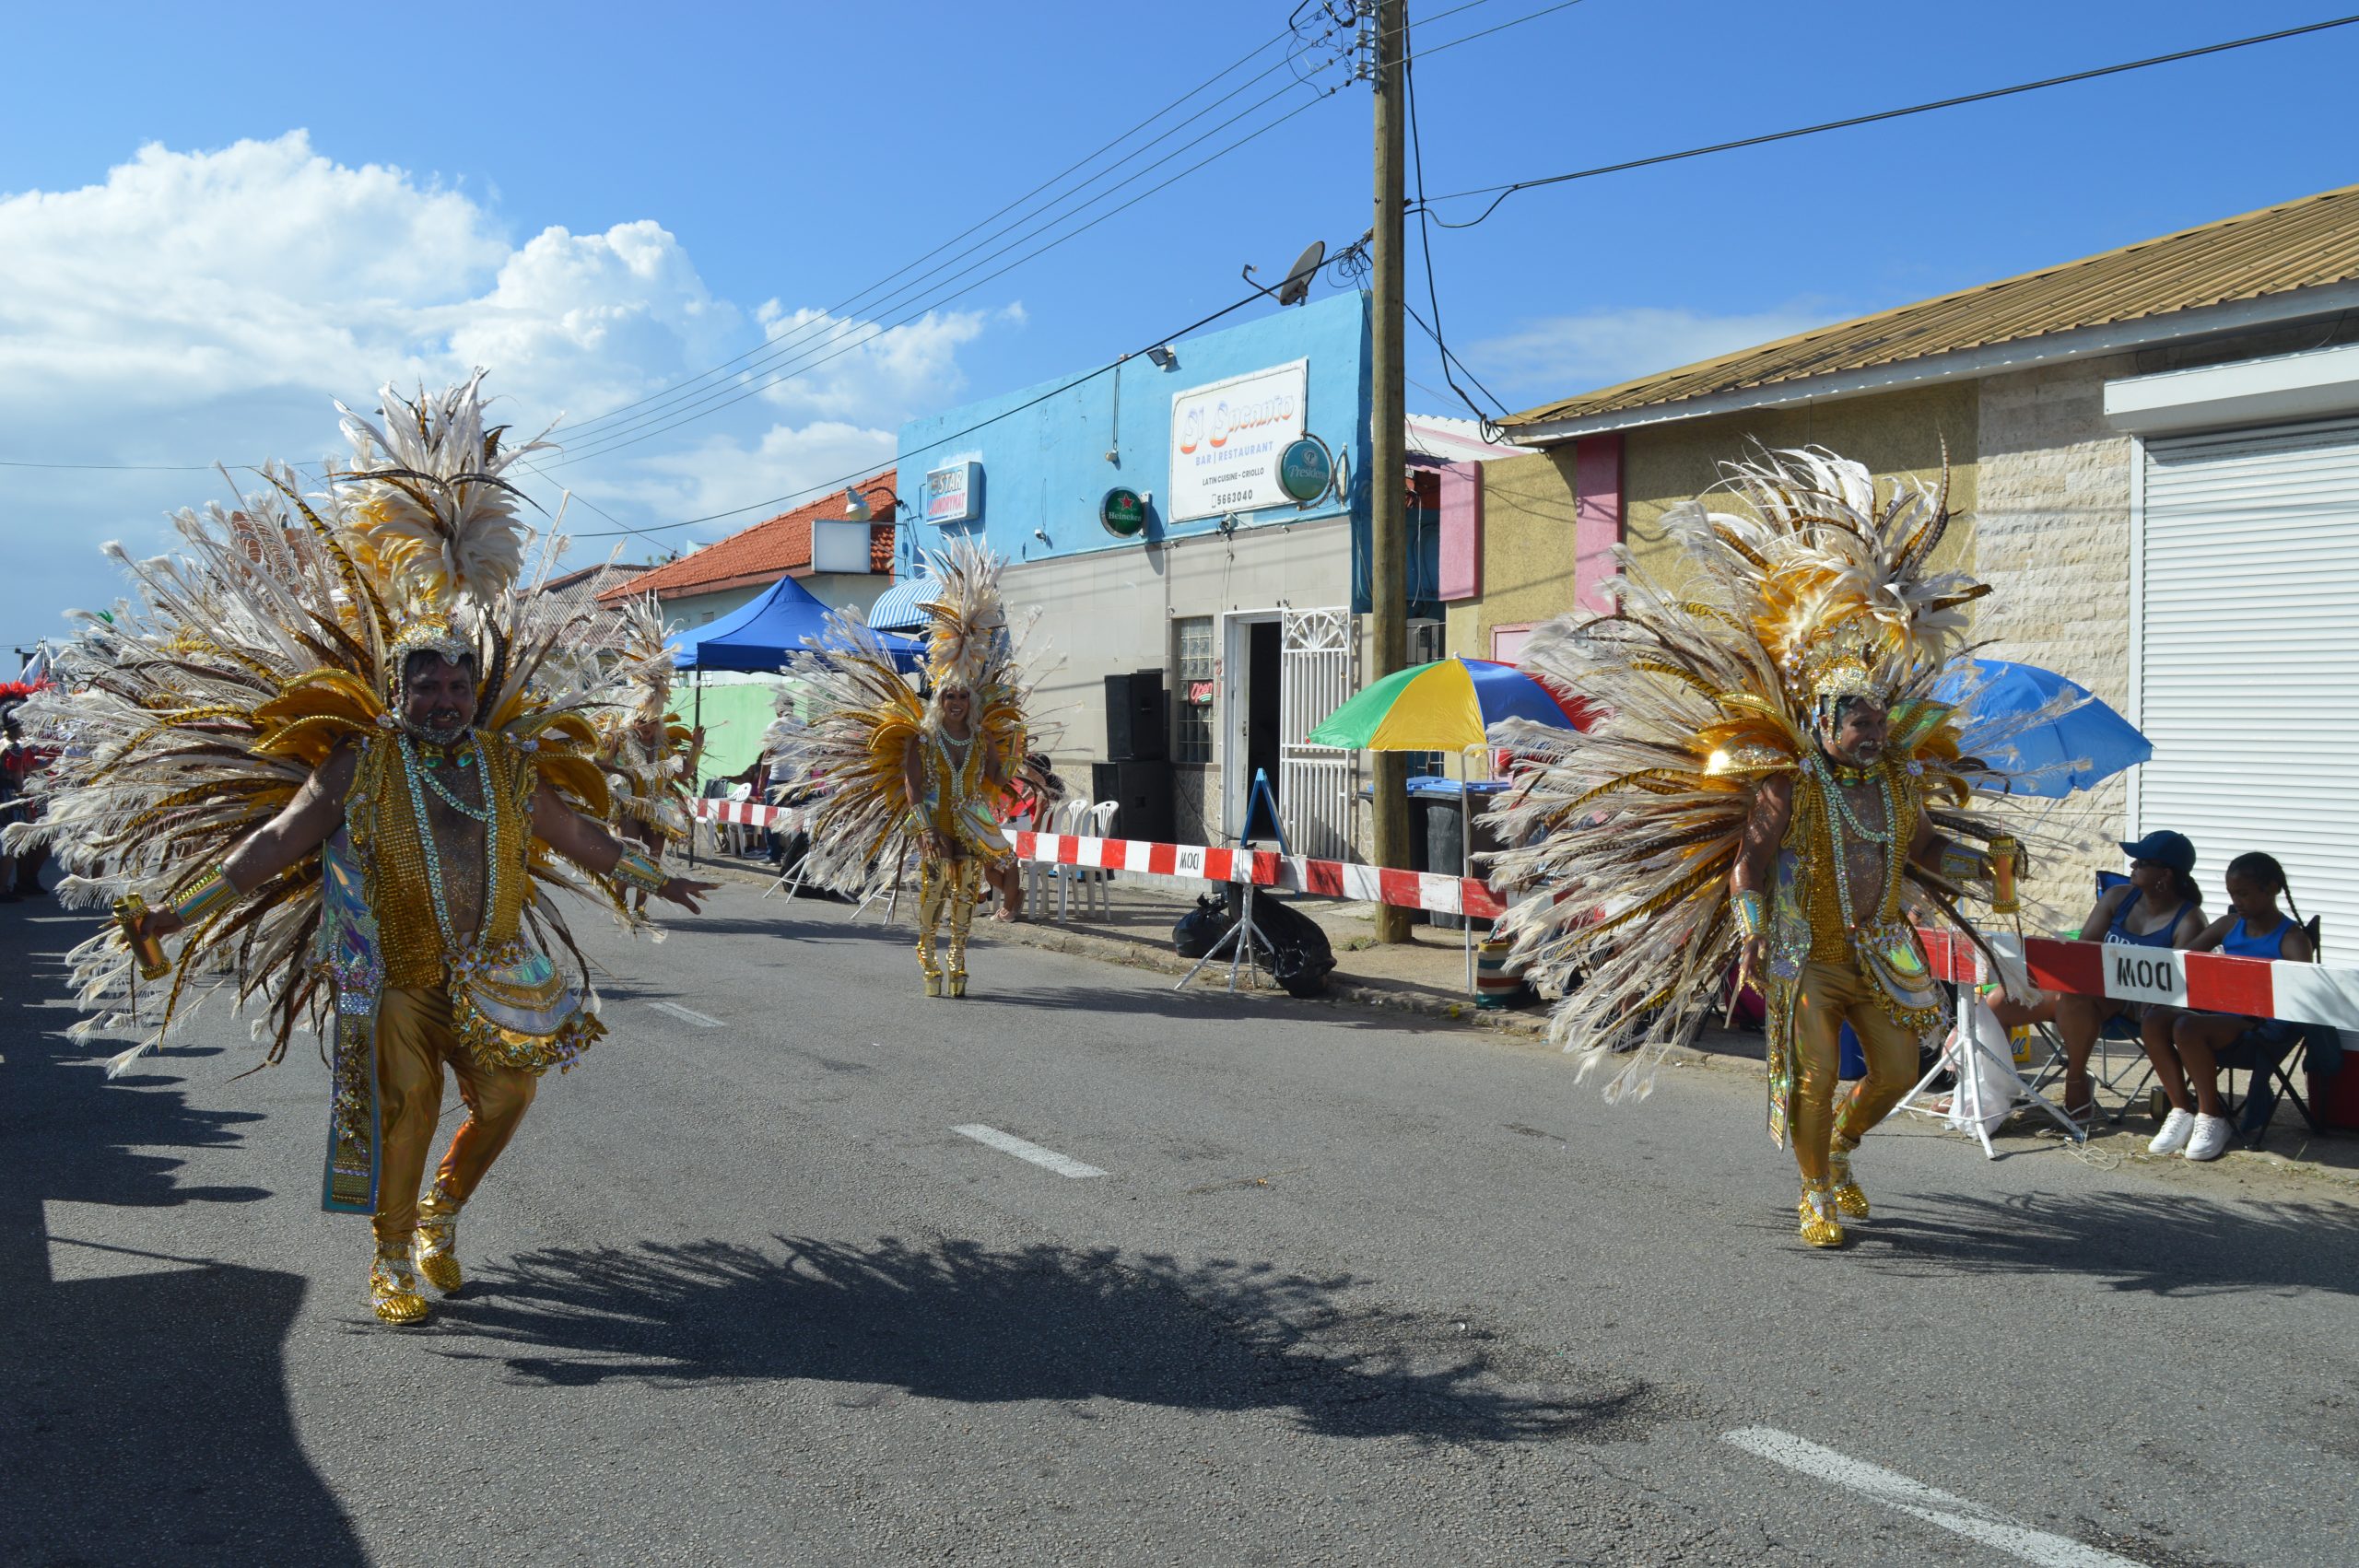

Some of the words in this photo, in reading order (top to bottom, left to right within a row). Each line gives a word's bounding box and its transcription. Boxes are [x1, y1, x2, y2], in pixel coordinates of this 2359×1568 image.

[1209, 395, 1294, 448] Encanto
[1195, 454, 1212, 465] BAR
[1218, 440, 1273, 462] RESTAURANT
[1203, 476, 1217, 486] LATIN
[1217, 473, 1238, 483] CUISINE
[1241, 467, 1264, 478] CRIOLLO
[1217, 489, 1253, 505] 5663040
[1109, 511, 1142, 521] Heineken
[1191, 683, 1213, 703] Open
